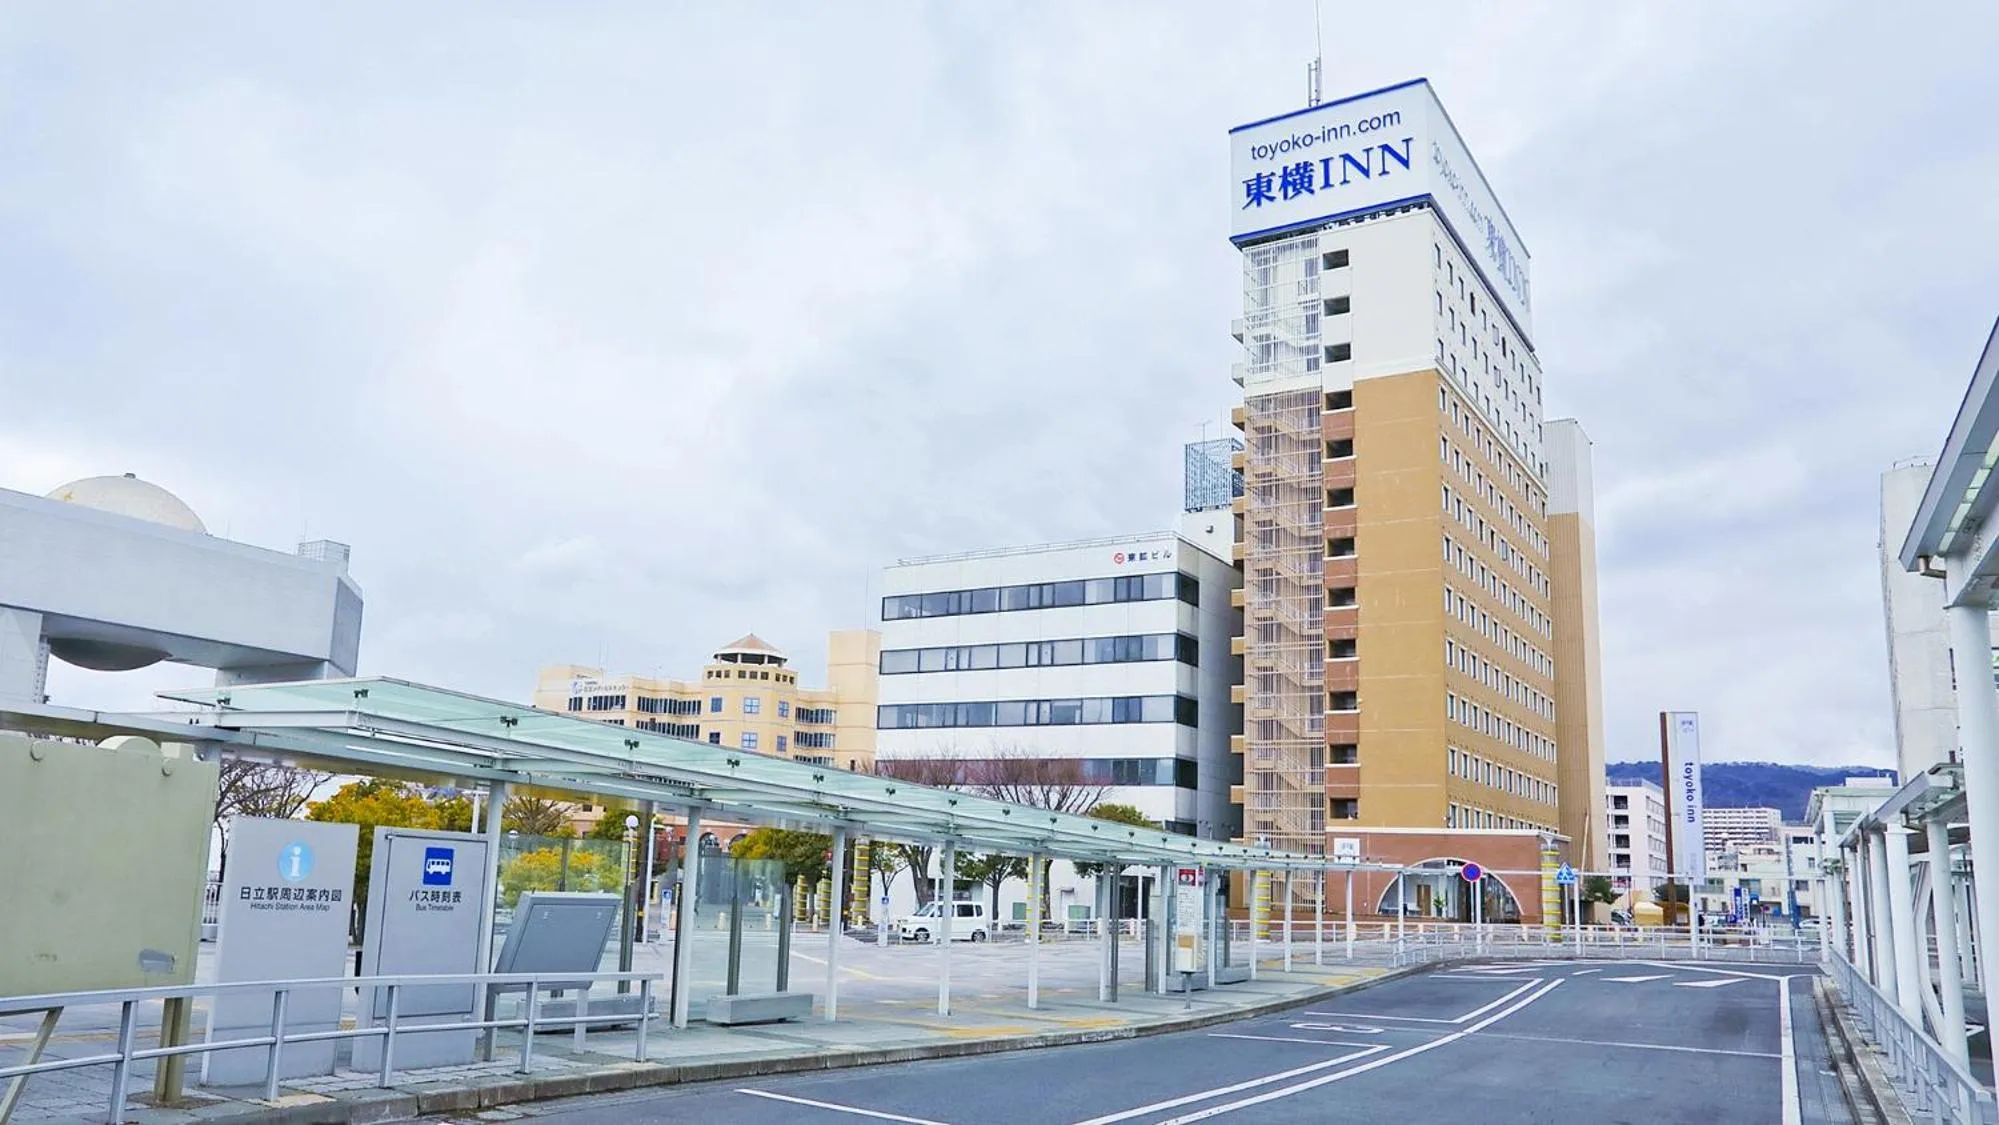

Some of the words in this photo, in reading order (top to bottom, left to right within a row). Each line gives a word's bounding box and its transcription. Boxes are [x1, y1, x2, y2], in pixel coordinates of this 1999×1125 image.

[1251, 111, 1401, 160] toyoko-inn.com
[1242, 137, 1413, 210] 東横INN
[1683, 762, 1697, 802] toyoko
[1687, 804, 1697, 823] inn
[240, 886, 342, 902] 日立駅周辺案内図
[409, 889, 462, 903] バス時刻表
[250, 902, 274, 910] Hitachi
[275, 902, 299, 911] Station
[300, 903, 315, 911] Area
